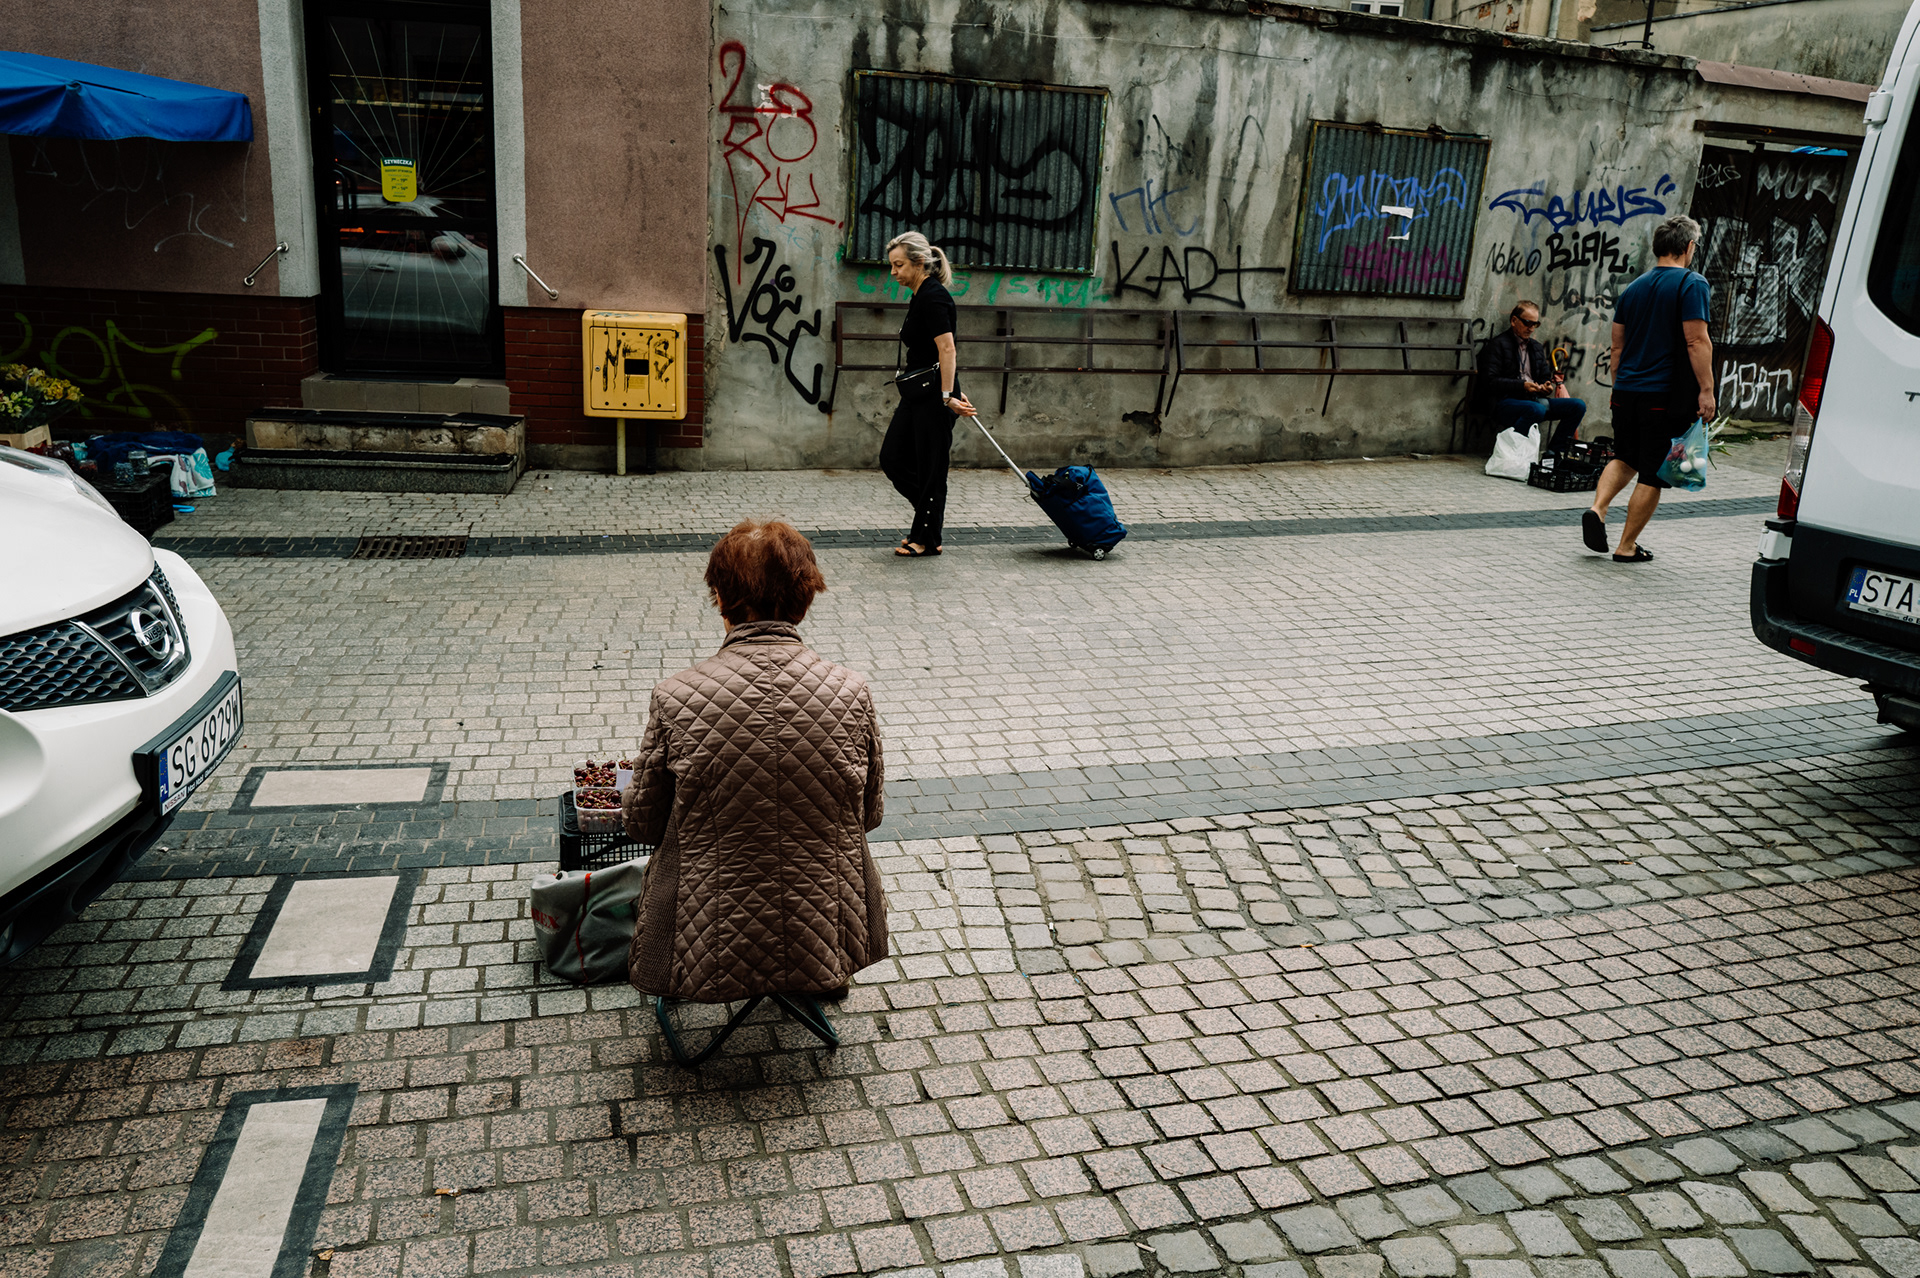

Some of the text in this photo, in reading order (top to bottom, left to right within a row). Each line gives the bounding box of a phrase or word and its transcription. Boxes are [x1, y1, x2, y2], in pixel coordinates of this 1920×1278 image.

[1849, 575, 1914, 613] PL STA
[160, 783, 168, 798] PL
[172, 736, 196, 789] SG
[201, 688, 240, 764] 6929W
